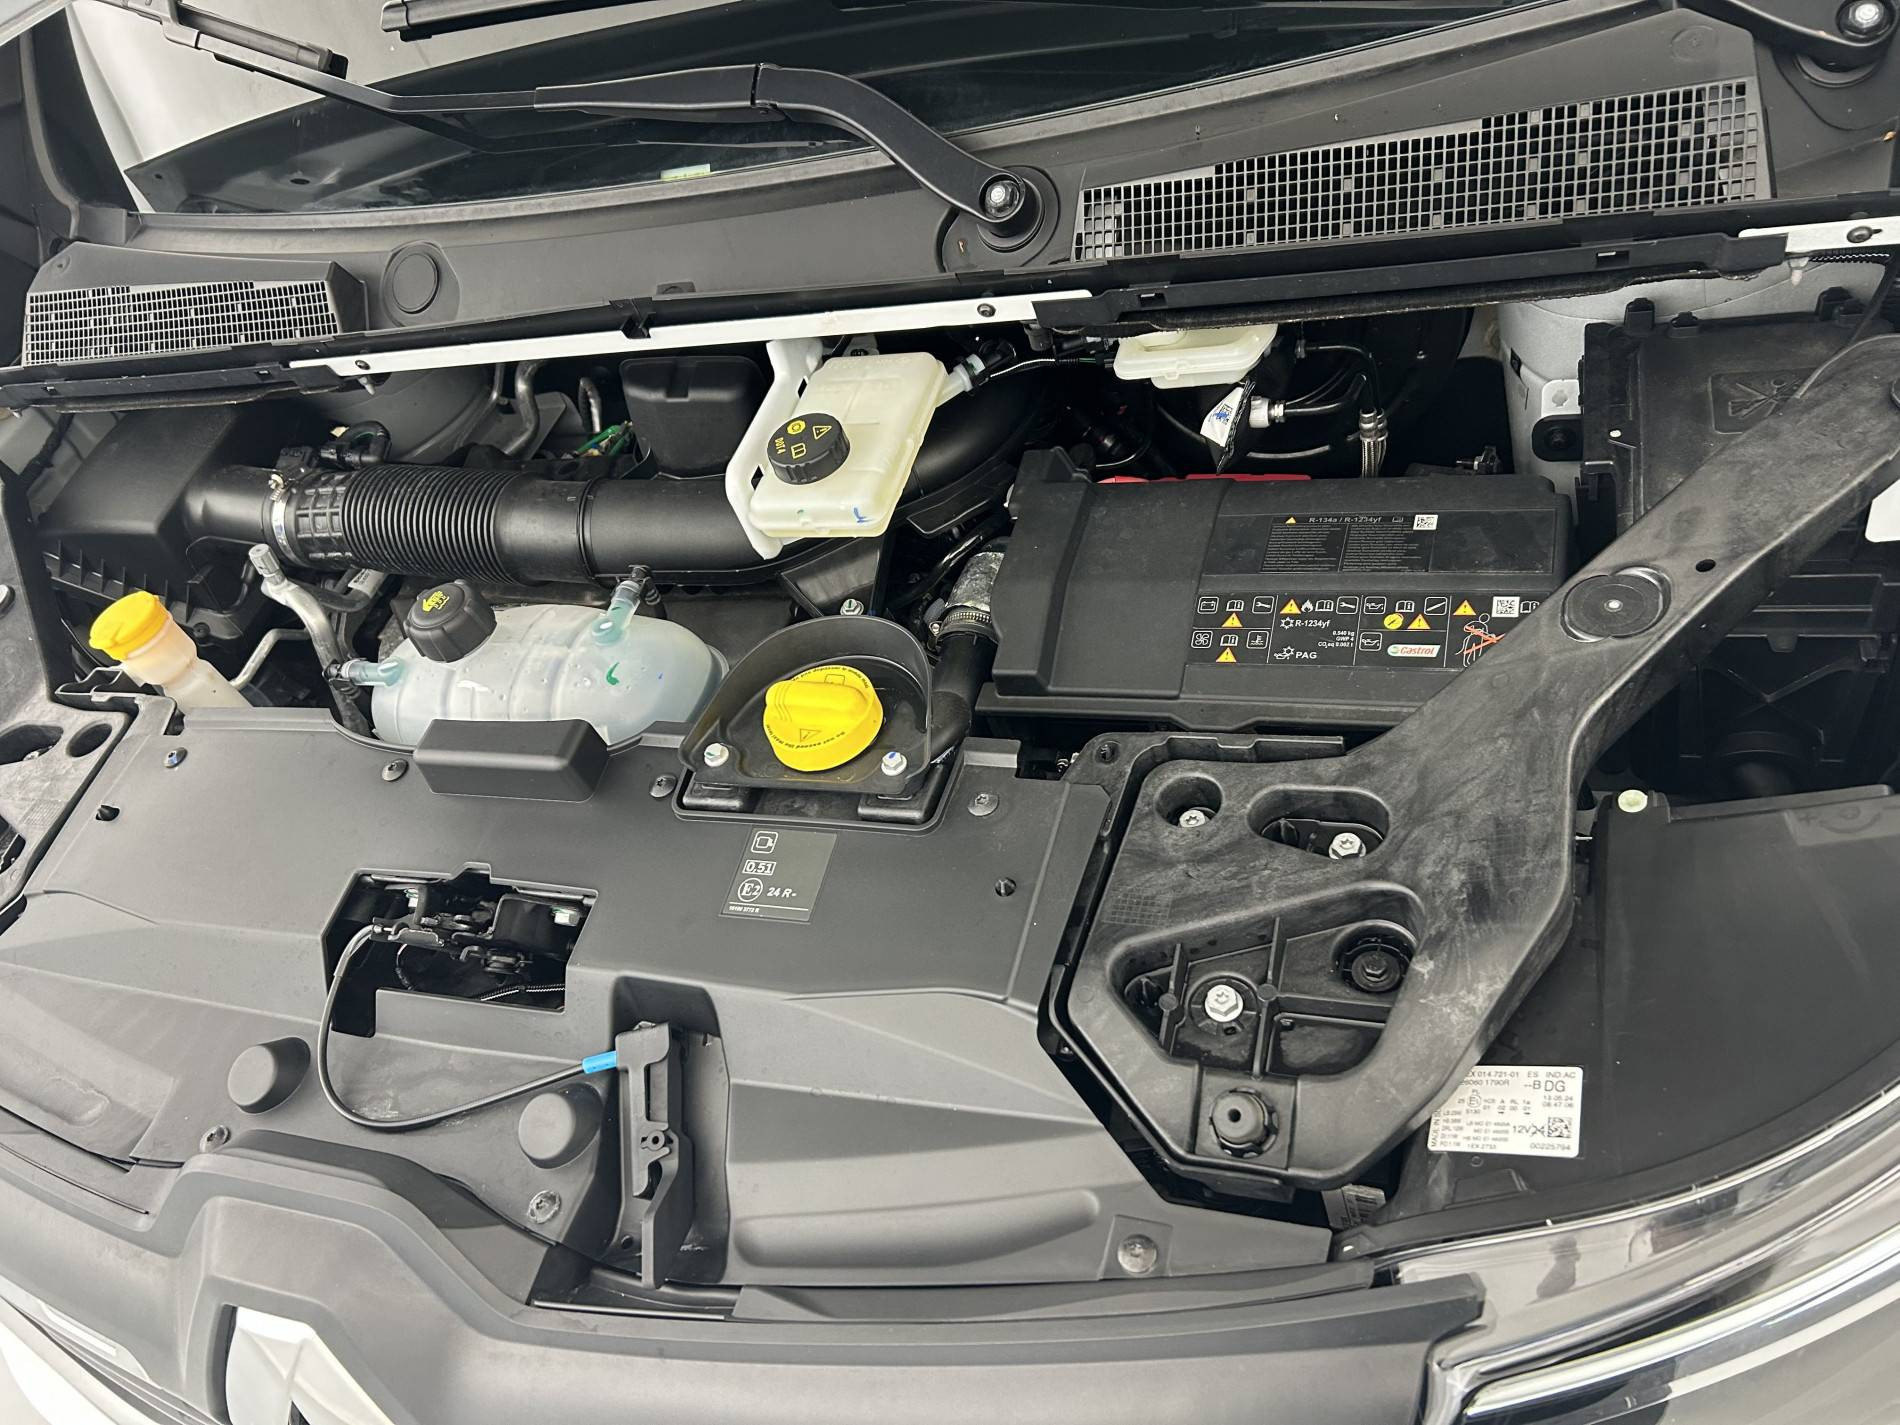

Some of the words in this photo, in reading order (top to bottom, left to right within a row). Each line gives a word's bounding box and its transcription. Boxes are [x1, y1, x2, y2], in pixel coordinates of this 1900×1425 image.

[1308, 516, 1338, 524] R-134a
[1344, 515, 1382, 525] R-1234yf
[1294, 619, 1331, 629] R-1234yf
[1295, 651, 1318, 659] PAG
[1400, 646, 1435, 656] Castrol
[823, 736, 836, 744] not
[740, 882, 761, 897] E2
[766, 887, 781, 897] 24
[1527, 1070, 1539, 1078] ES
[1543, 1079, 1566, 1093] DG
[1512, 1125, 1532, 1134] 12V
